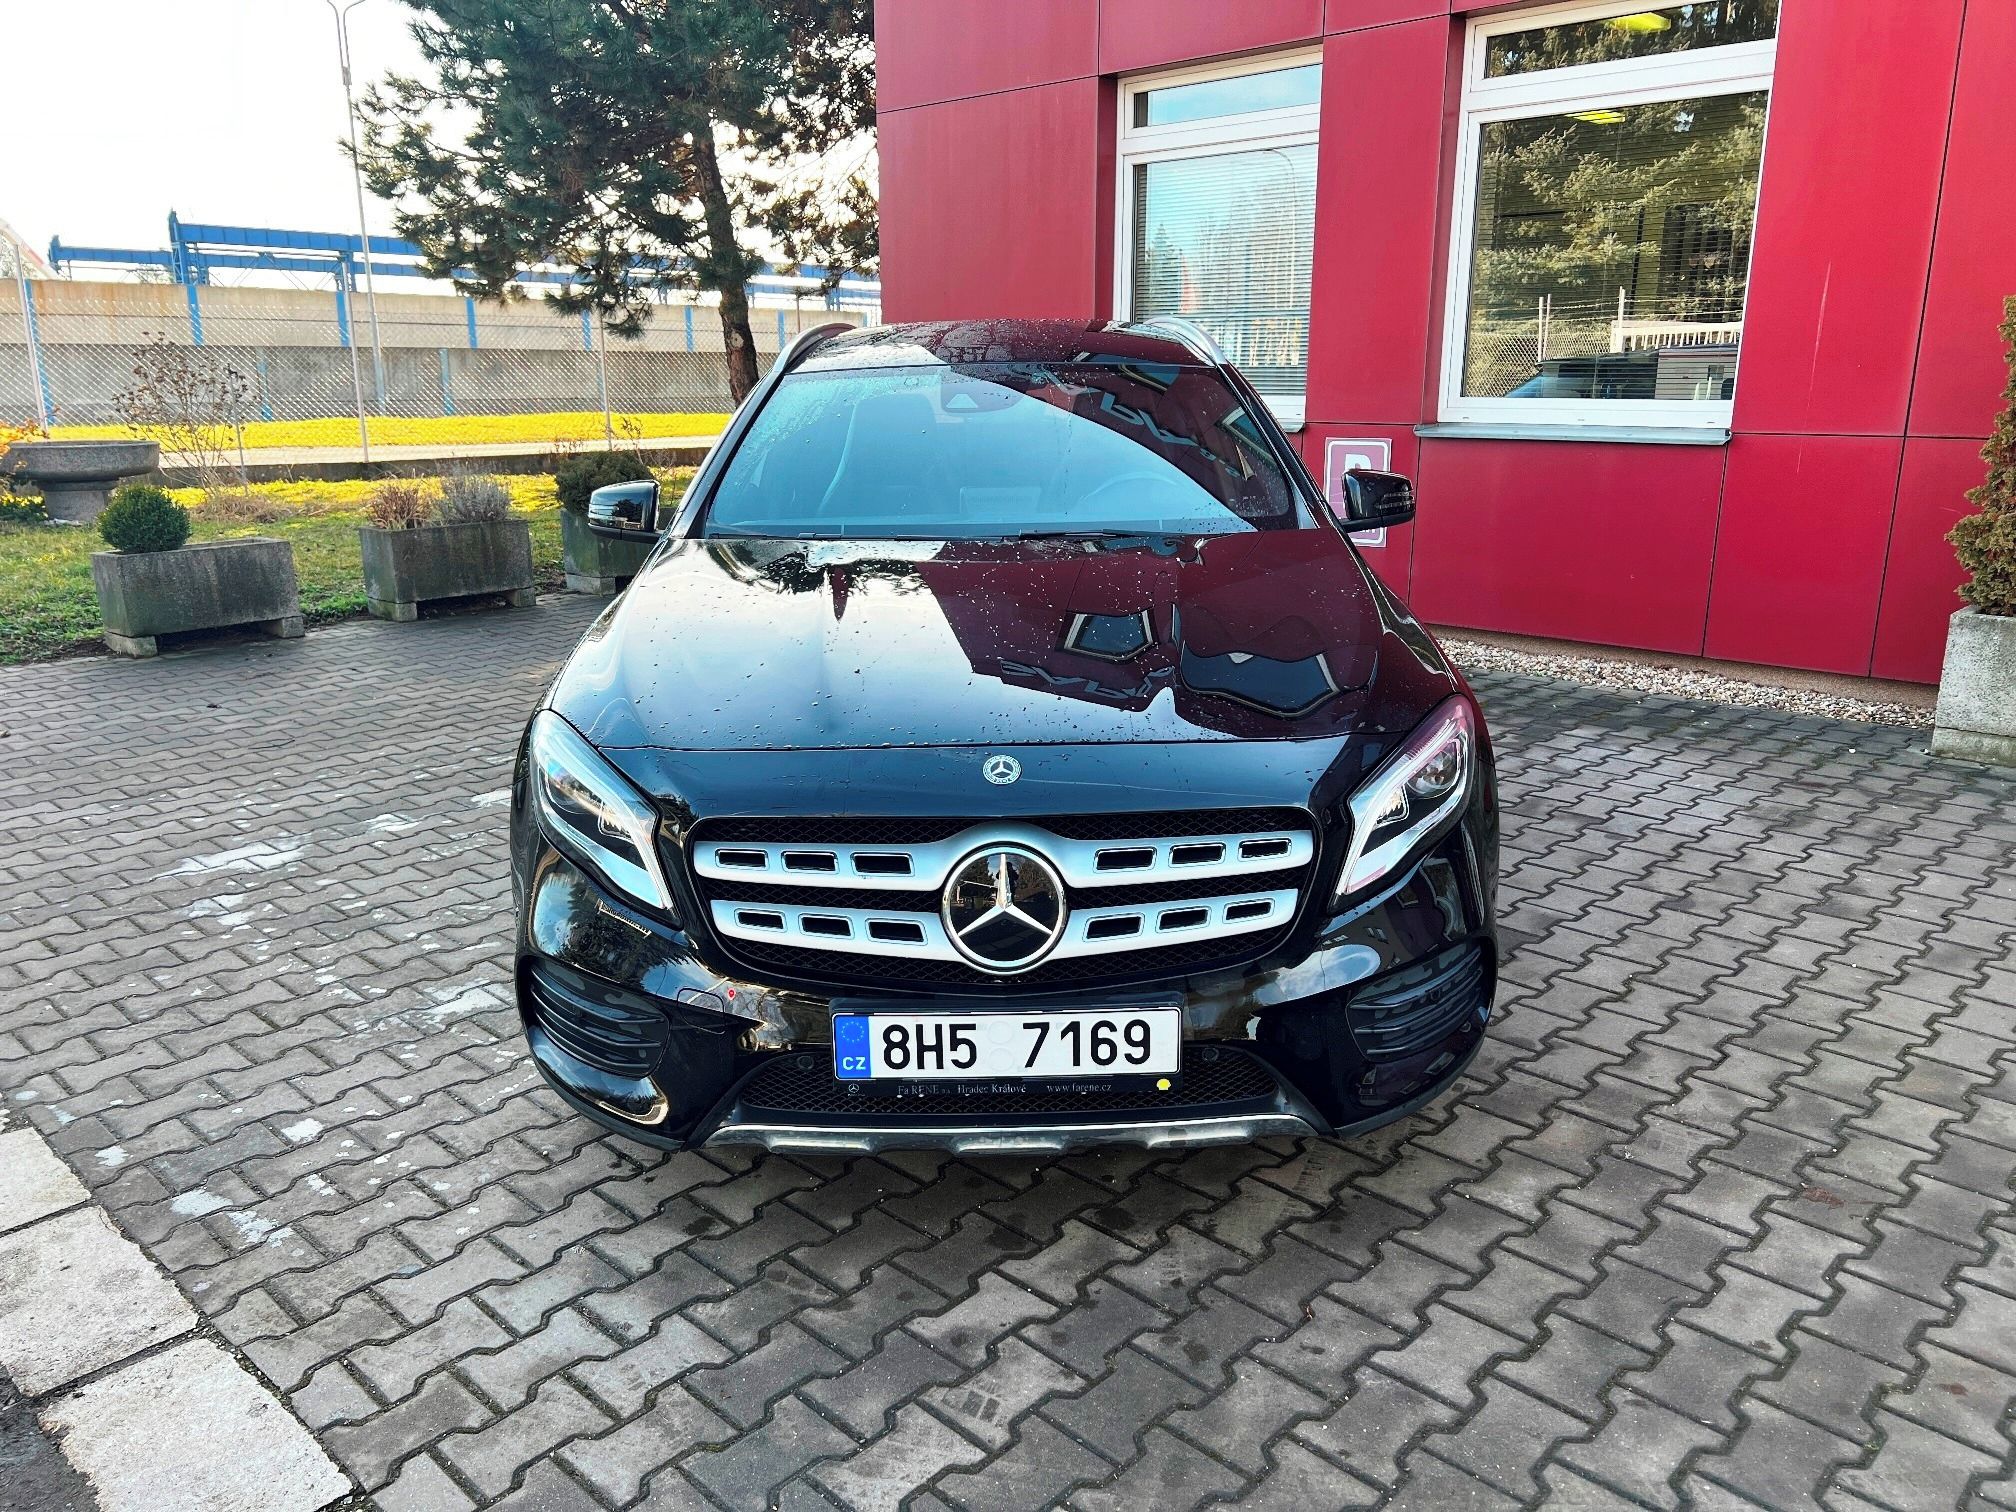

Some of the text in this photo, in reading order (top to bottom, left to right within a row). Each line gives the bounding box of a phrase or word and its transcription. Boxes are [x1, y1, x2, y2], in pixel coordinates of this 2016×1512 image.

[882, 1019, 1151, 1070] 8H5 7169
[842, 1056, 867, 1071] CZ
[911, 1084, 940, 1094] RENE
[957, 1084, 989, 1094] Hradec
[991, 1083, 1027, 1093] Králové
[1046, 1082, 1112, 1093] www.farene.cz
